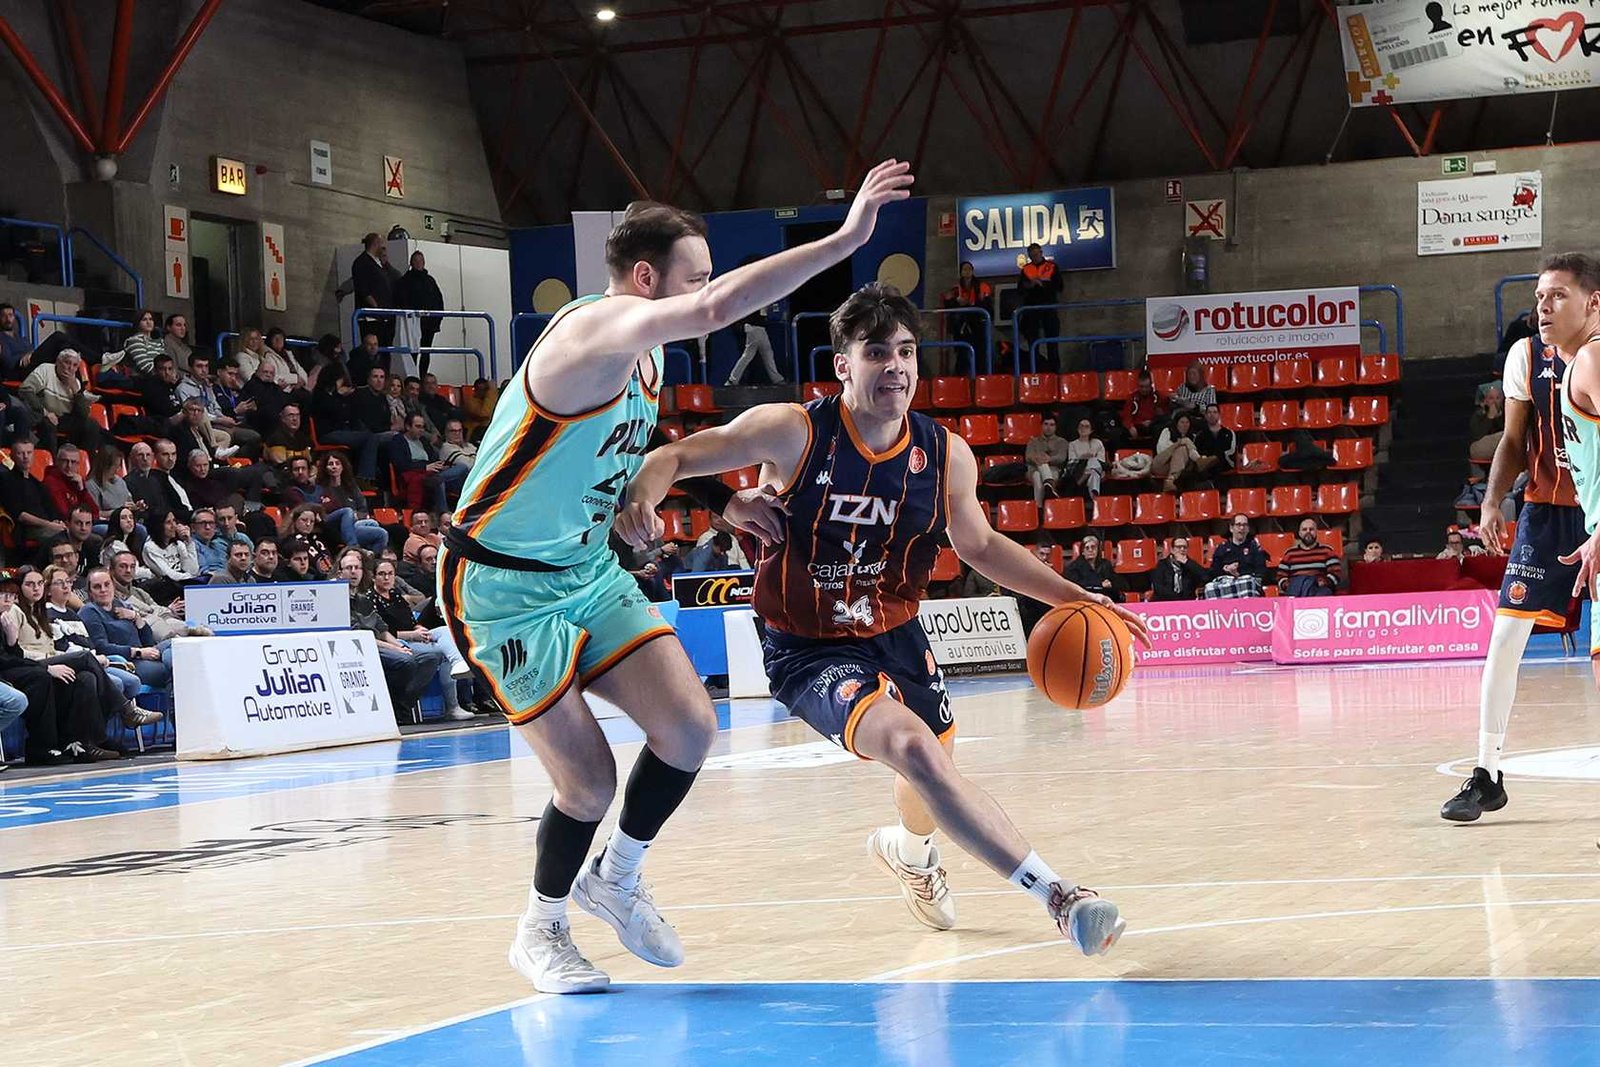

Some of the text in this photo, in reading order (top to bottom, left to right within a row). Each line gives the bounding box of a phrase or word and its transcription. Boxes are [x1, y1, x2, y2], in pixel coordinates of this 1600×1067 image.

[1453, 3, 1470, 15] La
[1479, 0, 1522, 20] mejor
[1457, 26, 1495, 47] en
[221, 165, 245, 187] BAR
[1421, 208, 1472, 225] Dona
[965, 203, 1071, 251] SALIDA
[1194, 295, 1355, 331] rotucolor
[1278, 334, 1285, 343] e
[1289, 331, 1335, 343] imagen
[1198, 350, 1310, 365] www.rotucolor.es
[232, 591, 277, 602] Grupo
[220, 602, 277, 614] Julian
[290, 603, 315, 611] GRANDE
[832, 594, 875, 626] 24
[1333, 604, 1480, 629] famaliving
[207, 613, 278, 625] Automotive
[921, 605, 1011, 641] upoUreta
[1138, 608, 1273, 633] famaliving
[1152, 631, 1201, 641] urgos
[1334, 628, 1399, 639] Burgos
[262, 644, 318, 669] Grupo
[947, 641, 1017, 659] automóviles
[1142, 651, 1171, 660] para
[1173, 646, 1227, 657] disfrutar
[1229, 647, 1245, 655] en
[1293, 643, 1479, 659] Sofás para disfrutar en casa
[255, 668, 326, 697] Julian
[340, 670, 369, 689] GRANDE
[243, 696, 333, 723] Automotive
